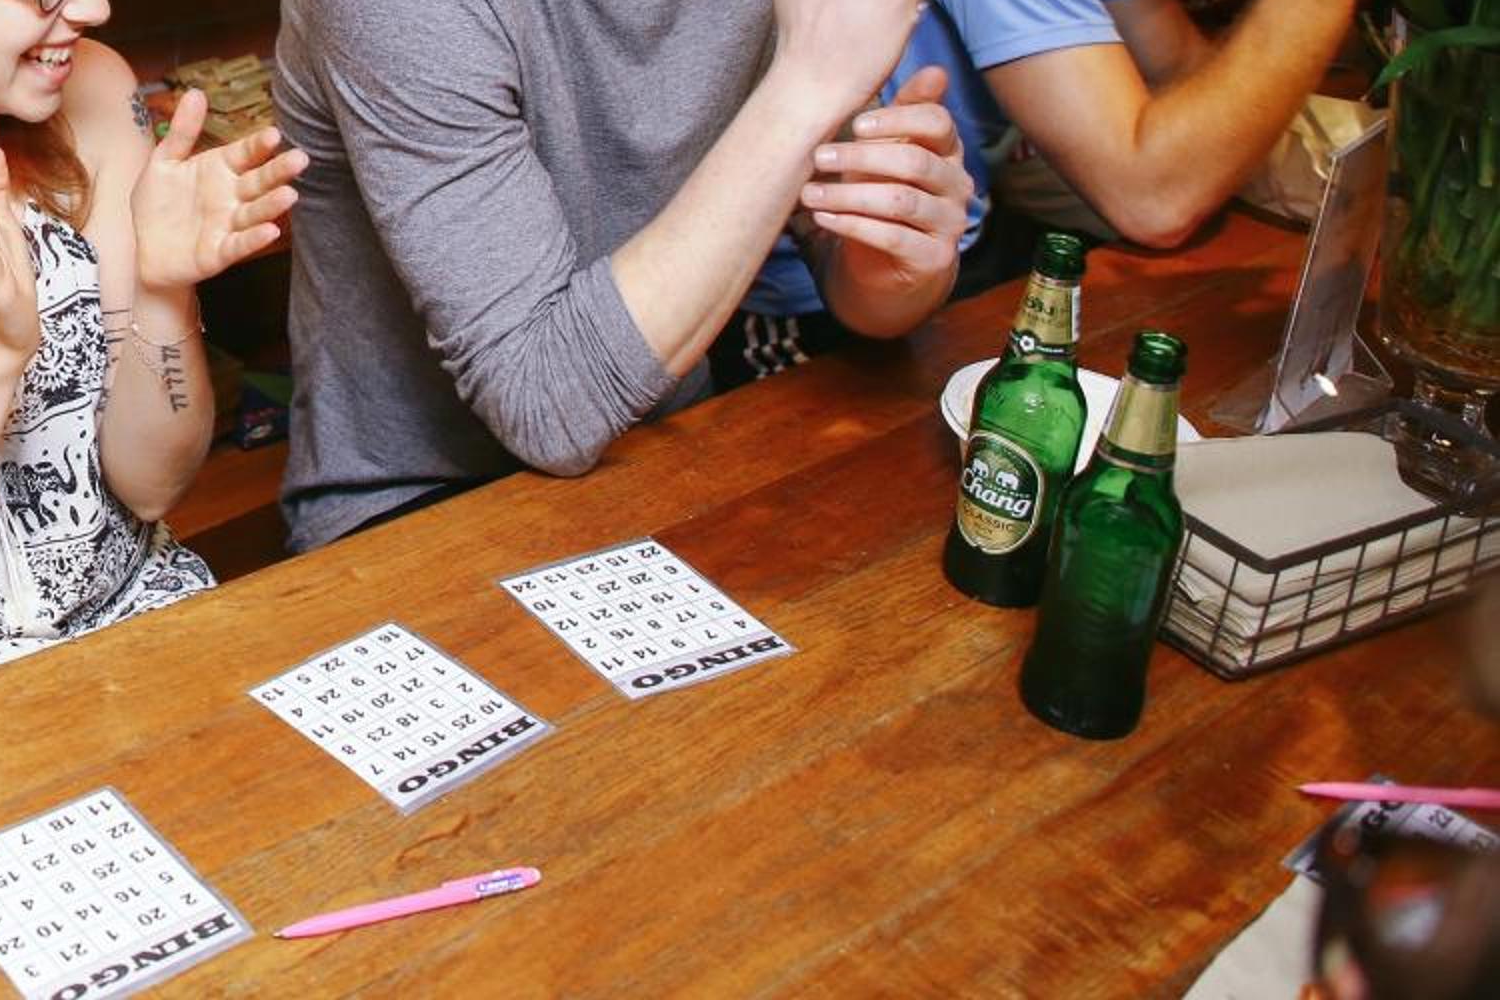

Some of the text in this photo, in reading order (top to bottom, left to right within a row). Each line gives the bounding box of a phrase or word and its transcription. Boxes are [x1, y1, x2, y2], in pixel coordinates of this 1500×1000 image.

[964, 467, 1032, 519] Chang
[511, 544, 662, 594] 22 15 23 13 24
[627, 571, 653, 586] 20
[596, 579, 622, 595] 25
[569, 591, 585, 601] 3
[532, 599, 557, 613] 10
[554, 583, 701, 632] 1 19 18 21 12
[709, 601, 725, 611] 5
[675, 609, 698, 623] 17
[376, 630, 402, 644] 16
[608, 627, 635, 641] 16
[581, 637, 598, 649] 2
[599, 619, 747, 672] 4 7 9 14 11
[319, 656, 346, 673] 22
[631, 636, 785, 689] BINGO
[290, 646, 427, 719] 17 12 9 24 4
[296, 674, 312, 685] 5
[261, 686, 285, 703] 13
[456, 682, 474, 694] 2
[311, 666, 447, 740] 1 21 20 19 11
[428, 698, 445, 709] 3
[395, 712, 420, 728] 18
[366, 726, 393, 742] 23
[369, 699, 504, 776] 10 25 15 14 7
[398, 716, 537, 793] BINGO
[87, 800, 112, 816] 11
[48, 815, 76, 832] 18
[106, 821, 135, 839] 22
[21, 832, 34, 846] 7
[70, 839, 97, 855] 19
[31, 852, 60, 872] 23
[129, 846, 156, 863] 13
[91, 860, 121, 880] 25
[158, 872, 175, 884] 5
[114, 887, 141, 903] 16
[20, 898, 35, 911] 4
[74, 903, 102, 921] 14
[23, 892, 197, 979] 2 20 1 21 3
[36, 921, 63, 938] 10
[51, 911, 234, 1000] BINGO
